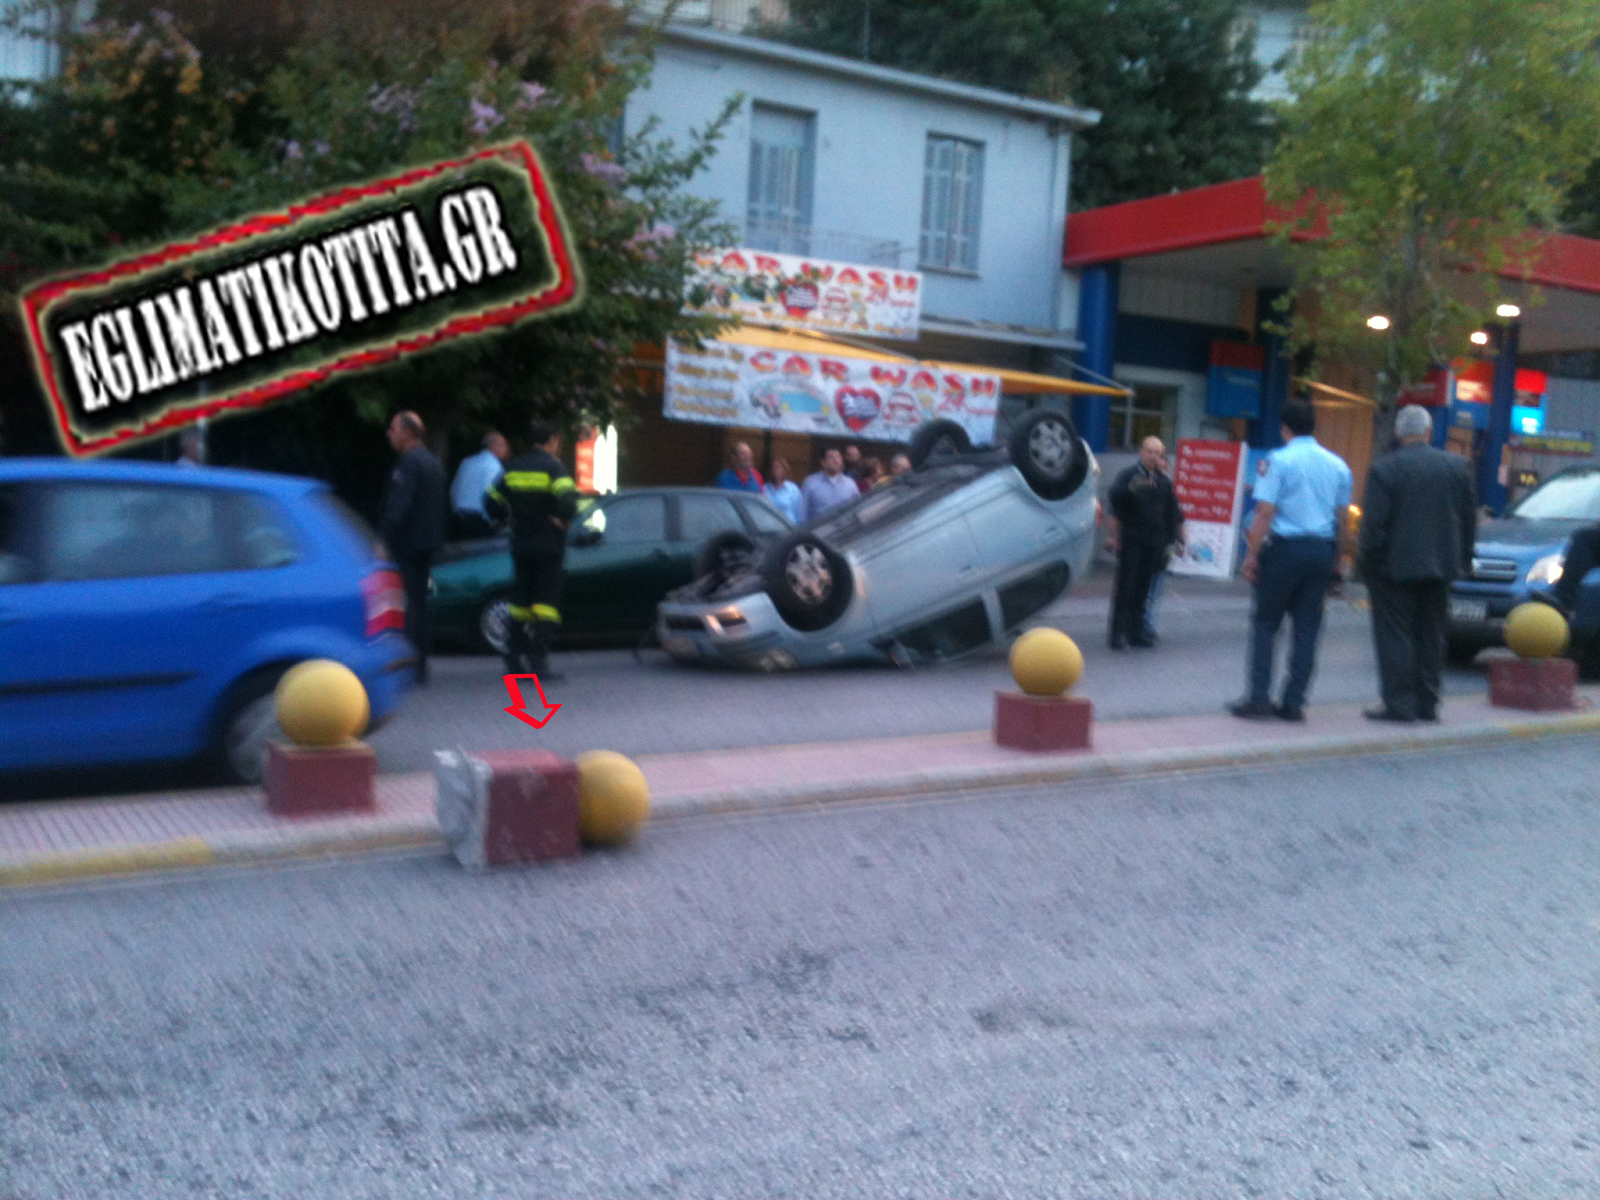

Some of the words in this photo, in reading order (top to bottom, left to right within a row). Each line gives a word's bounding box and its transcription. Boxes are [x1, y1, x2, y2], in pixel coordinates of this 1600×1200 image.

[801, 262, 918, 294] WASH
[750, 351, 848, 382] CAR
[870, 365, 996, 396] WASH
